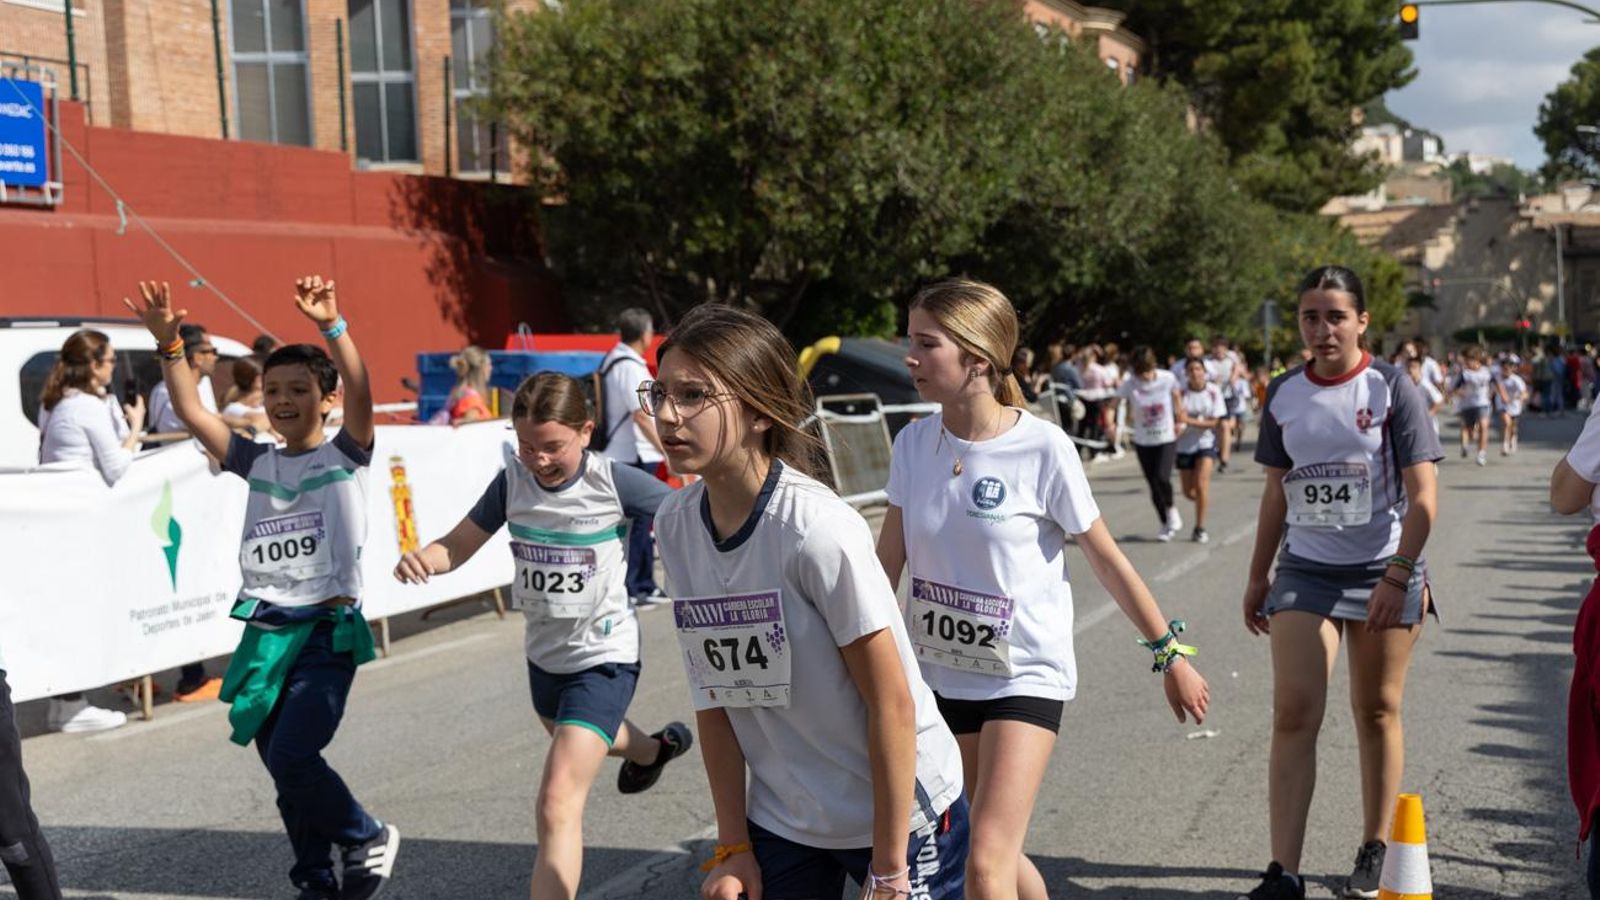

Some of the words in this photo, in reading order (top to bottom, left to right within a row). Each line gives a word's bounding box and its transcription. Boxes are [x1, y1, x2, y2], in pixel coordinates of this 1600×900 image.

[1304, 483, 1351, 505] 934
[252, 535, 317, 565] 1009
[521, 567, 585, 594] 1023
[129, 604, 168, 621] Patronato
[172, 595, 211, 612] Municipal
[723, 600, 747, 611] CARRERA
[747, 597, 775, 609] ESCOLAR
[730, 610, 739, 621] LA
[741, 608, 769, 621] GLORIA
[143, 619, 180, 635] Deportes
[922, 609, 996, 650] 1092
[703, 635, 769, 672] 674
